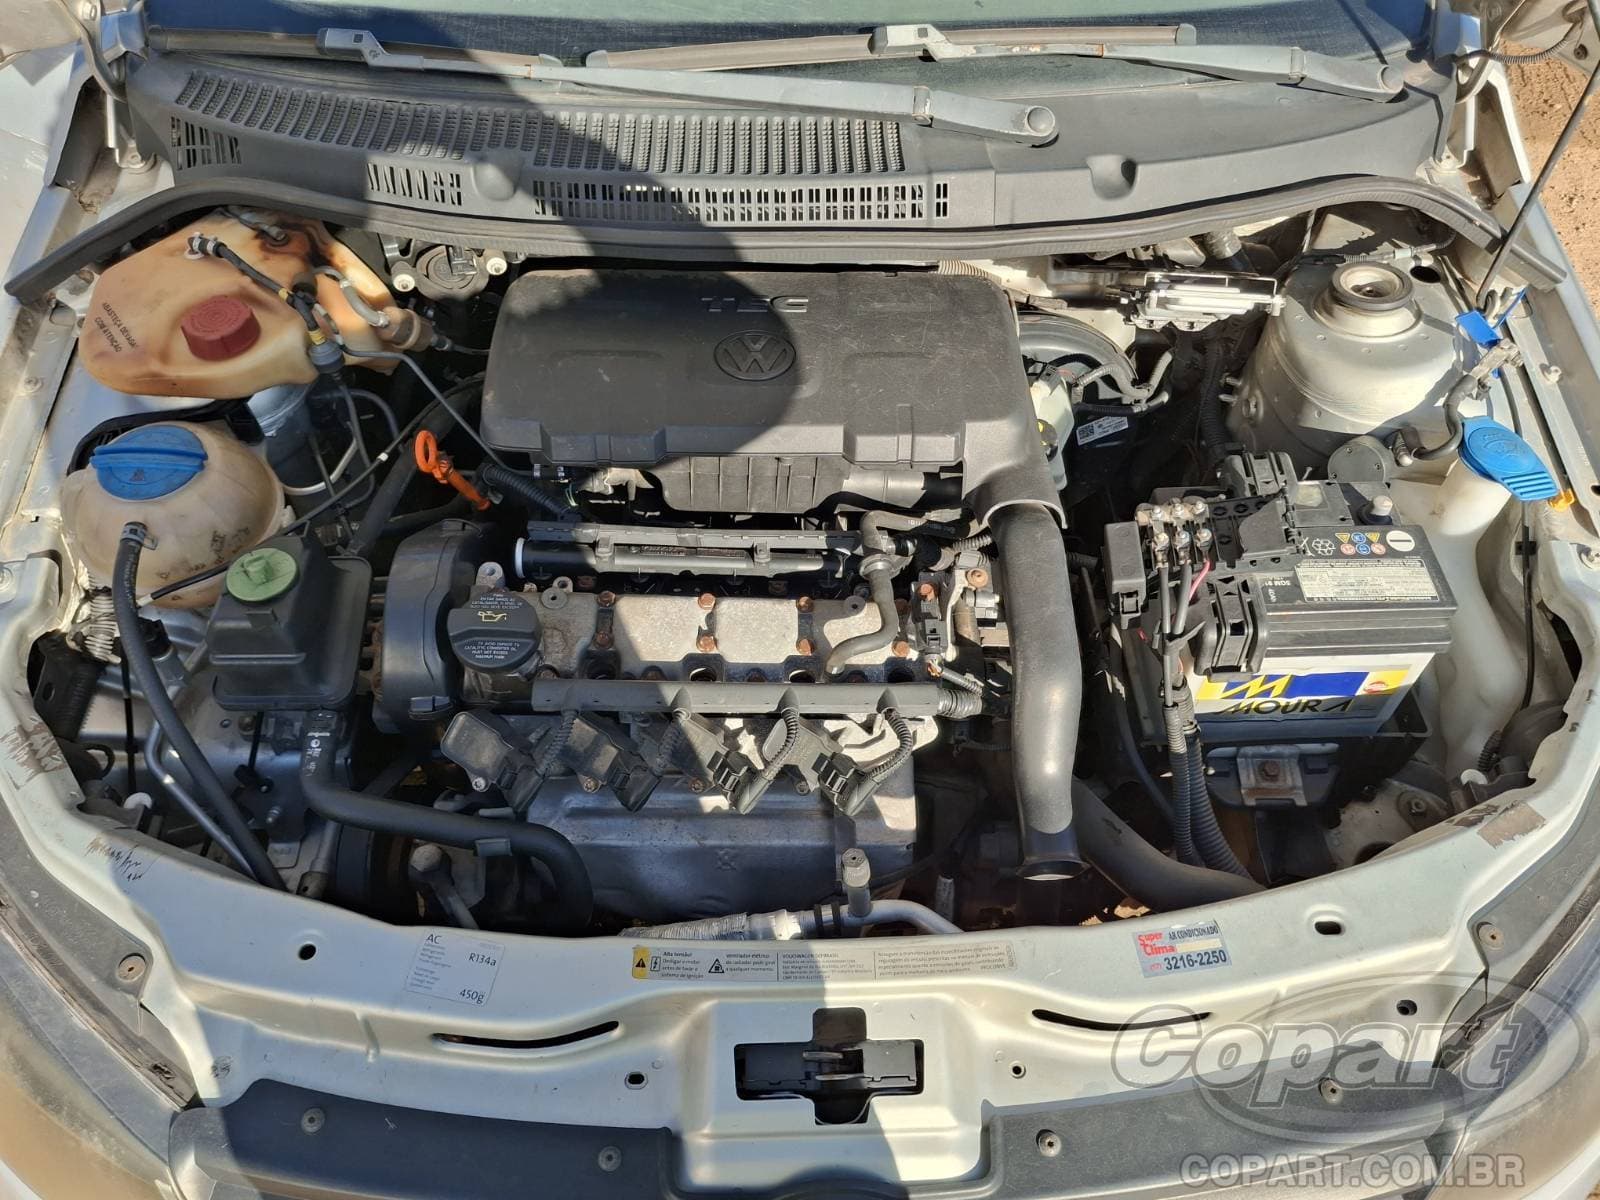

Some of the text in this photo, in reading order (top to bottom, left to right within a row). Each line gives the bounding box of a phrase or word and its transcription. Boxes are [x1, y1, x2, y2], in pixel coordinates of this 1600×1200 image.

[1214, 696, 1353, 715] MOURA
[426, 933, 442, 945] AC
[468, 952, 497, 967] R134a
[459, 988, 485, 1005] 450g
